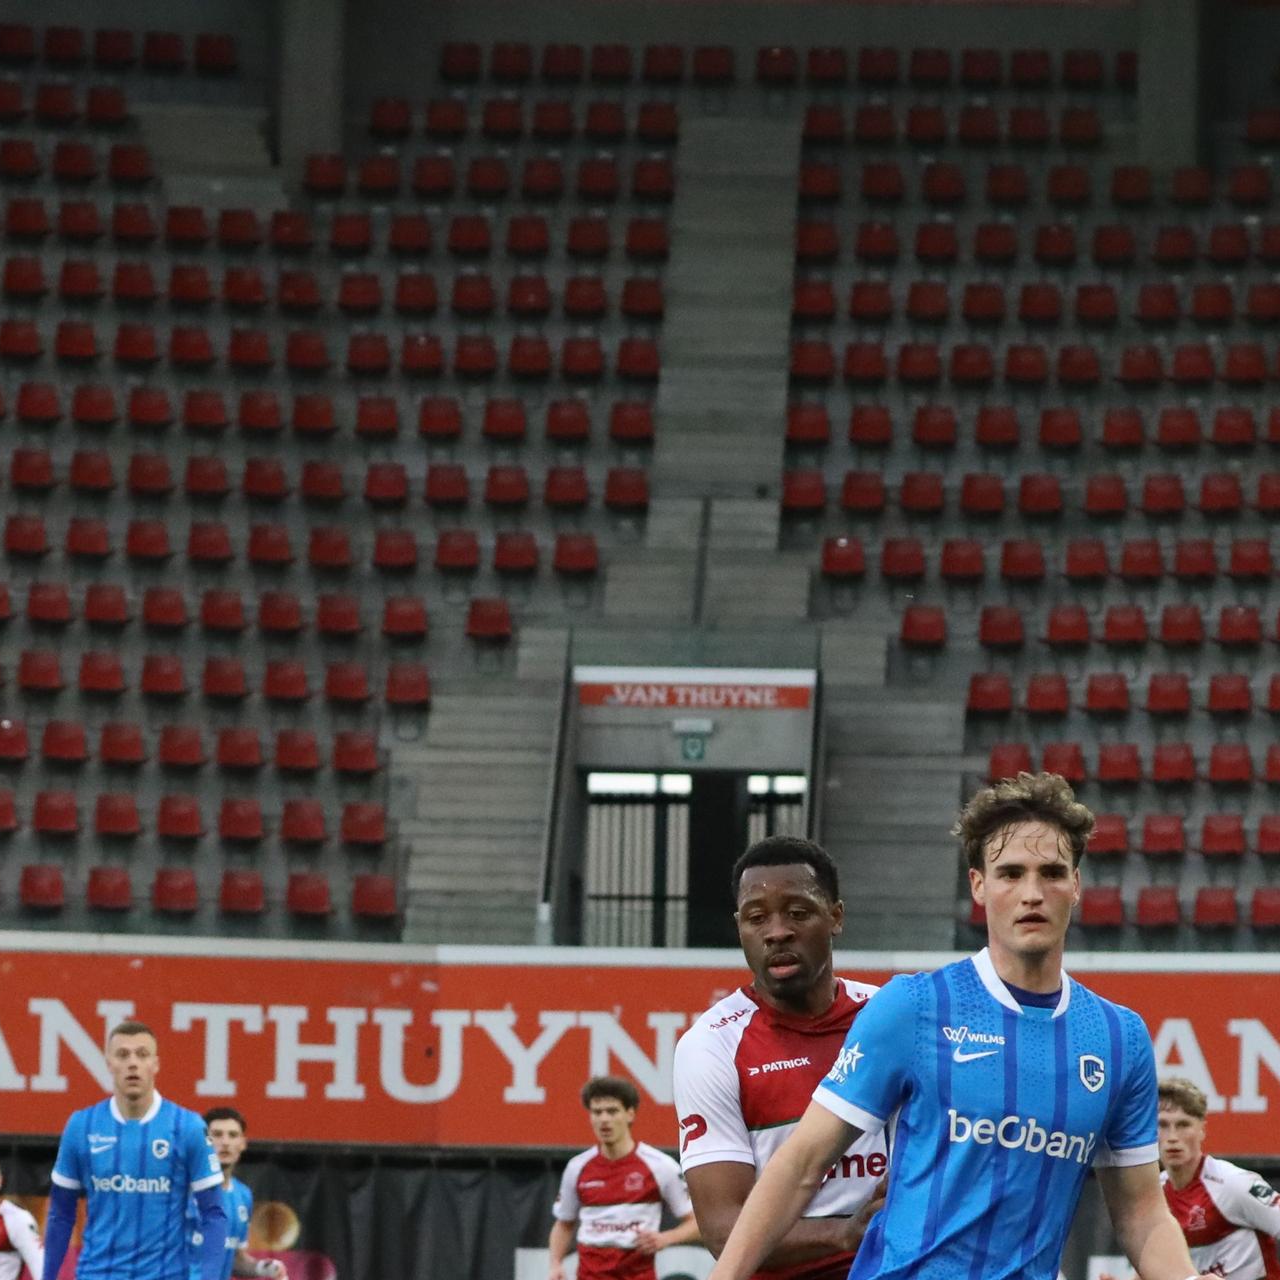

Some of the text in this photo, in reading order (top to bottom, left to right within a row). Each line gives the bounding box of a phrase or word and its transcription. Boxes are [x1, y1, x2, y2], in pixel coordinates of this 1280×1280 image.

[611, 684, 778, 706] VAN THUYNE
[967, 1032, 1006, 1046] WILMS
[171, 1003, 702, 1104] THUYN
[761, 1056, 812, 1074] PATRICK
